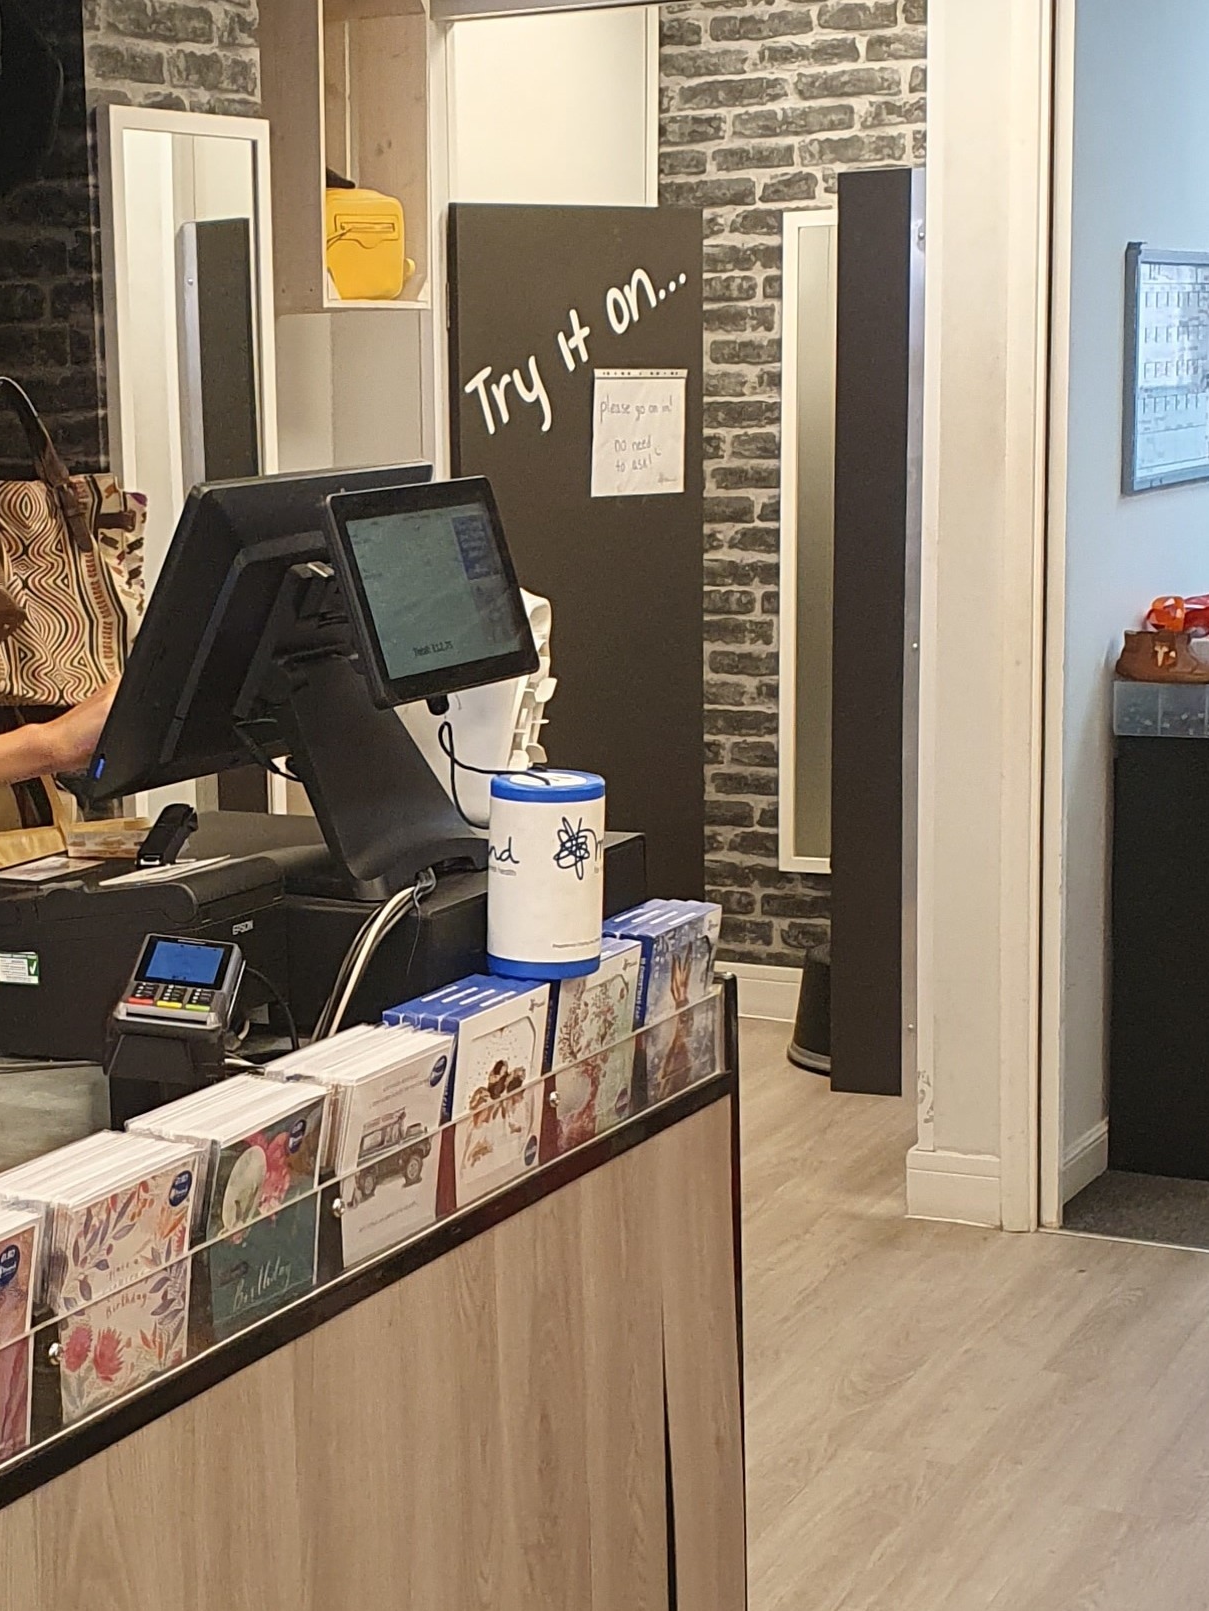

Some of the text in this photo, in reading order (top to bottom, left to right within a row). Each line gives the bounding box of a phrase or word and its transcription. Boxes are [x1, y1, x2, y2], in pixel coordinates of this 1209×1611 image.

[464, 355, 552, 435] Try
[606, 268, 686, 334] on...
[600, 394, 630, 424] please
[635, 405, 646, 421] go
[648, 404, 658, 414] on
[632, 435, 651, 451] need
[615, 460, 626, 472] to
[489, 836, 520, 864] nd
[232, 920, 254, 936] EPSON
[106, 1293, 147, 1319] Birthday
